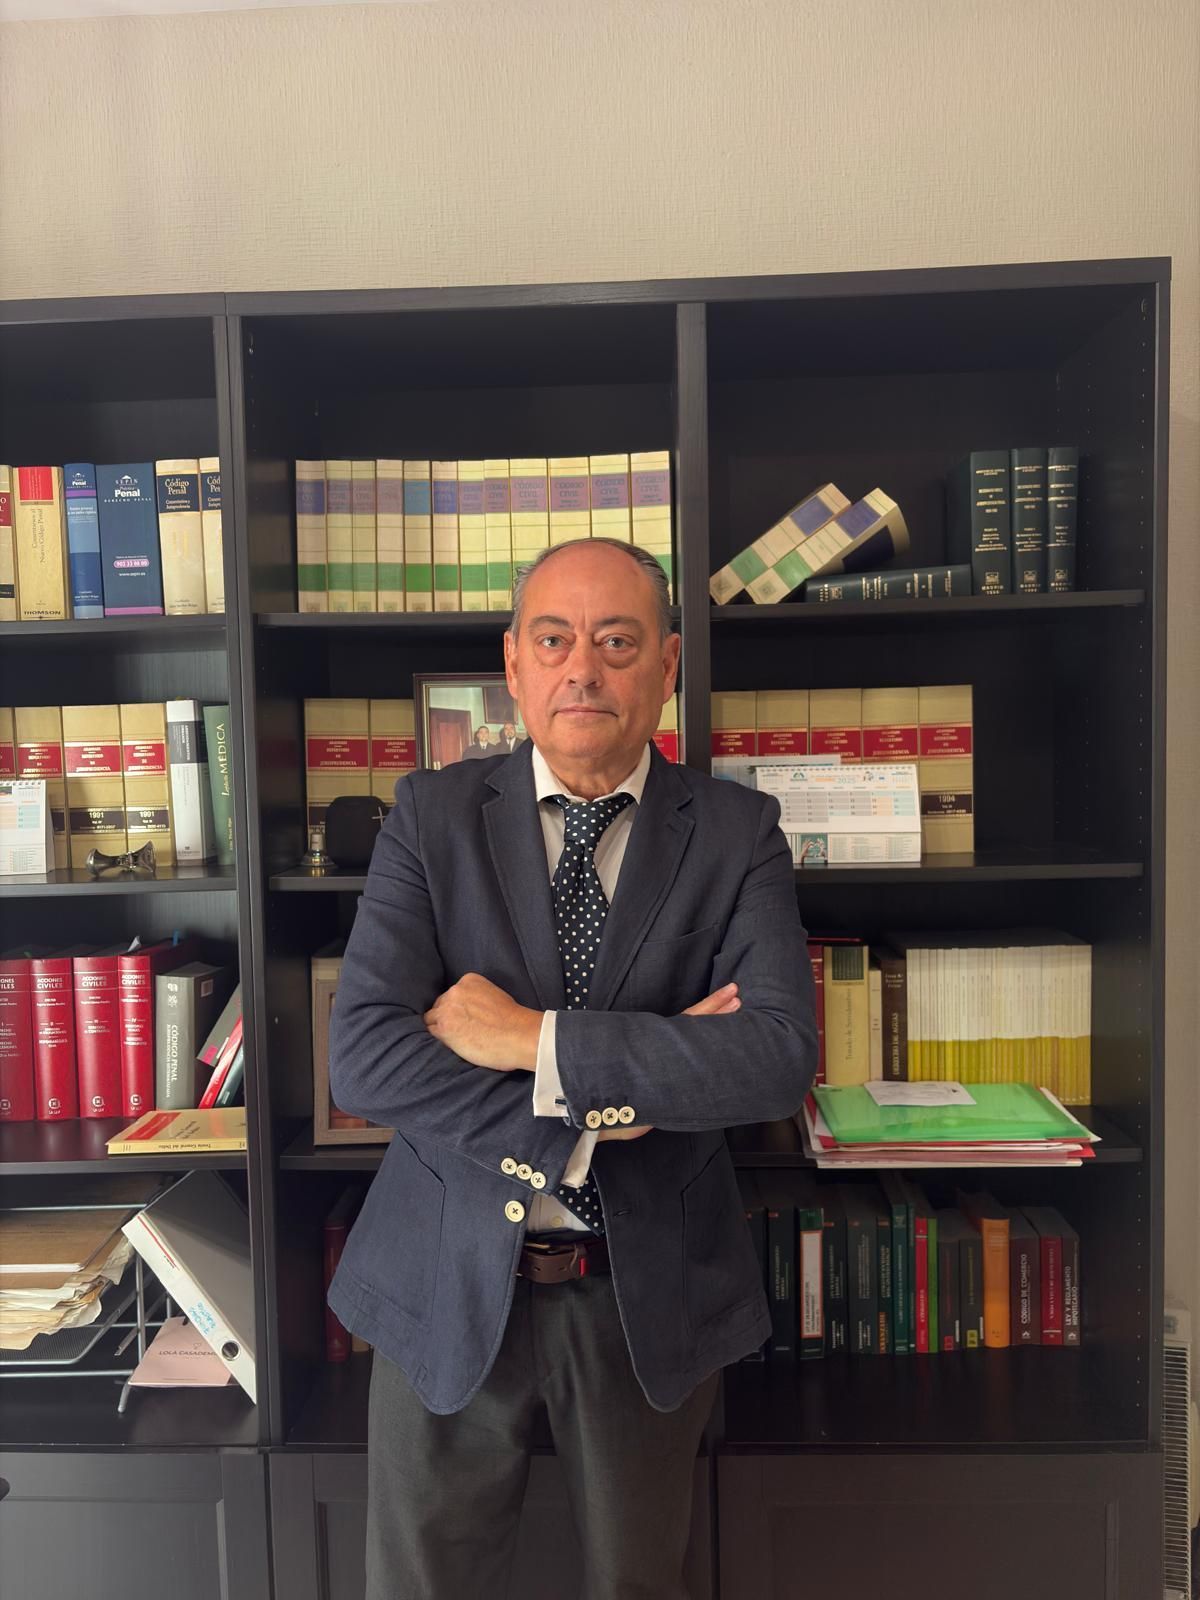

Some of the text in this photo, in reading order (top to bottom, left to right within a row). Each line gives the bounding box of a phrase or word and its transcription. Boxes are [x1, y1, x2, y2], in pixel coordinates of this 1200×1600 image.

[165, 479, 189, 489] Código
[168, 487, 186, 495] Penal
[171, 1024, 180, 1057] CÓDIGO
